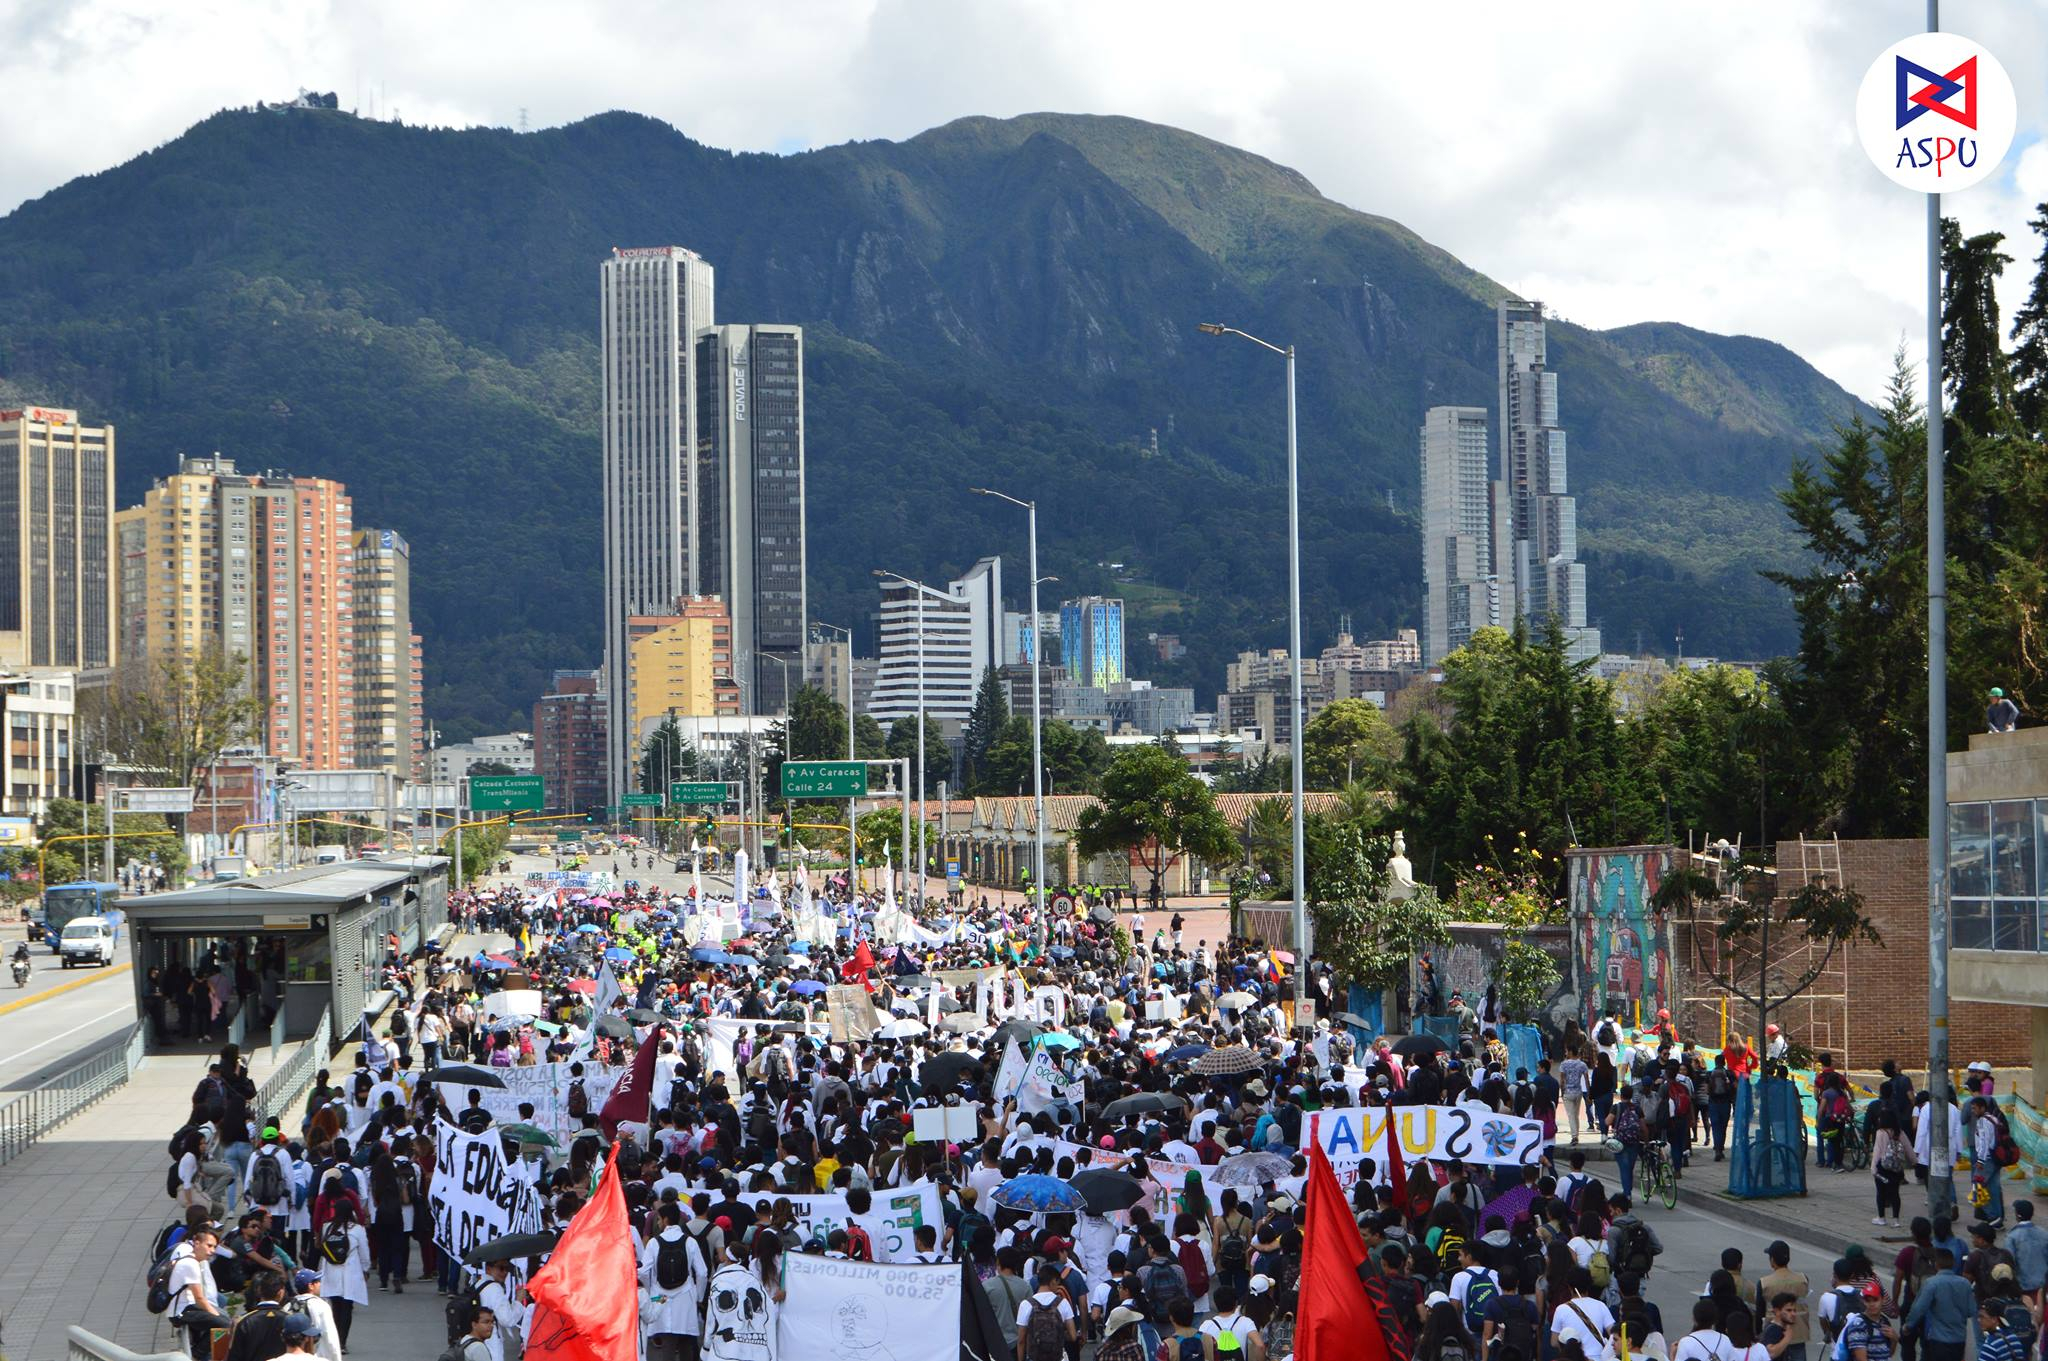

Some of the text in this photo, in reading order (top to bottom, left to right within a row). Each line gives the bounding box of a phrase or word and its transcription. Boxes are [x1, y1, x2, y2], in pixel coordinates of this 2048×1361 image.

[623, 247, 667, 257] COLPATRIA
[735, 368, 745, 421] FONADE
[800, 768, 861, 777] Av Caracas
[787, 782, 833, 792] Calle 24
[1058, 901, 1068, 912] 60
[1476, 1288, 1493, 1303] adidas
